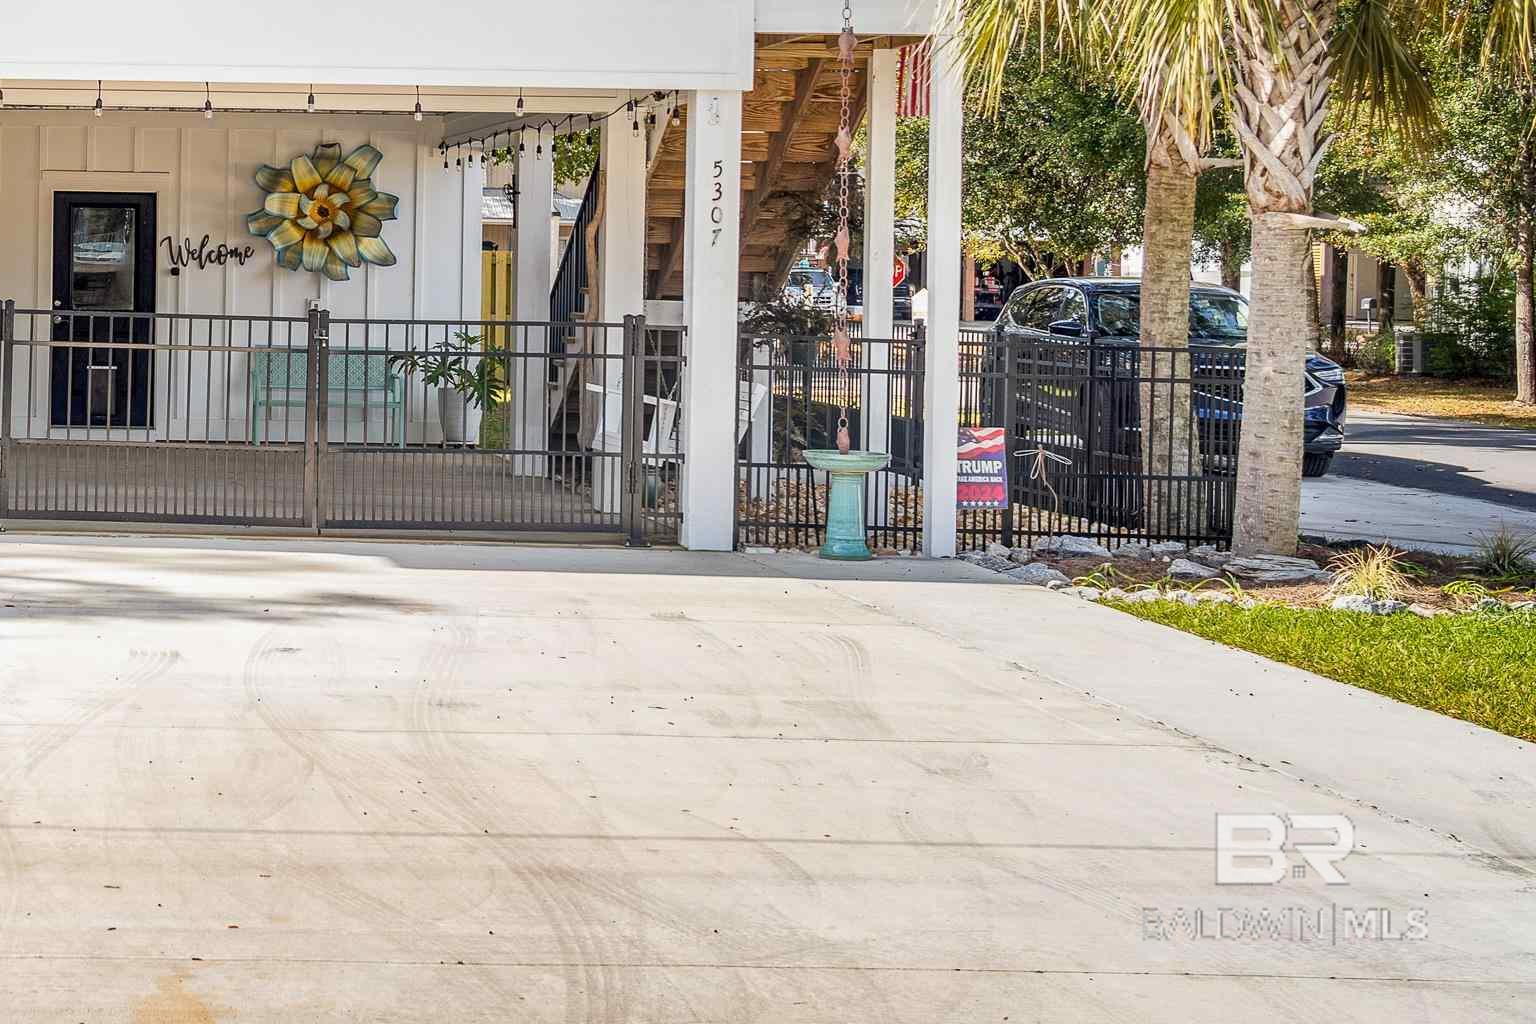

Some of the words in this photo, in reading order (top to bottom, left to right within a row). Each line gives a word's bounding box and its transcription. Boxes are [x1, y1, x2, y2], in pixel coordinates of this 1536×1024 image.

[710, 160, 723, 247] 5307
[160, 234, 255, 270] Welcome
[958, 460, 1003, 474] TRUMP
